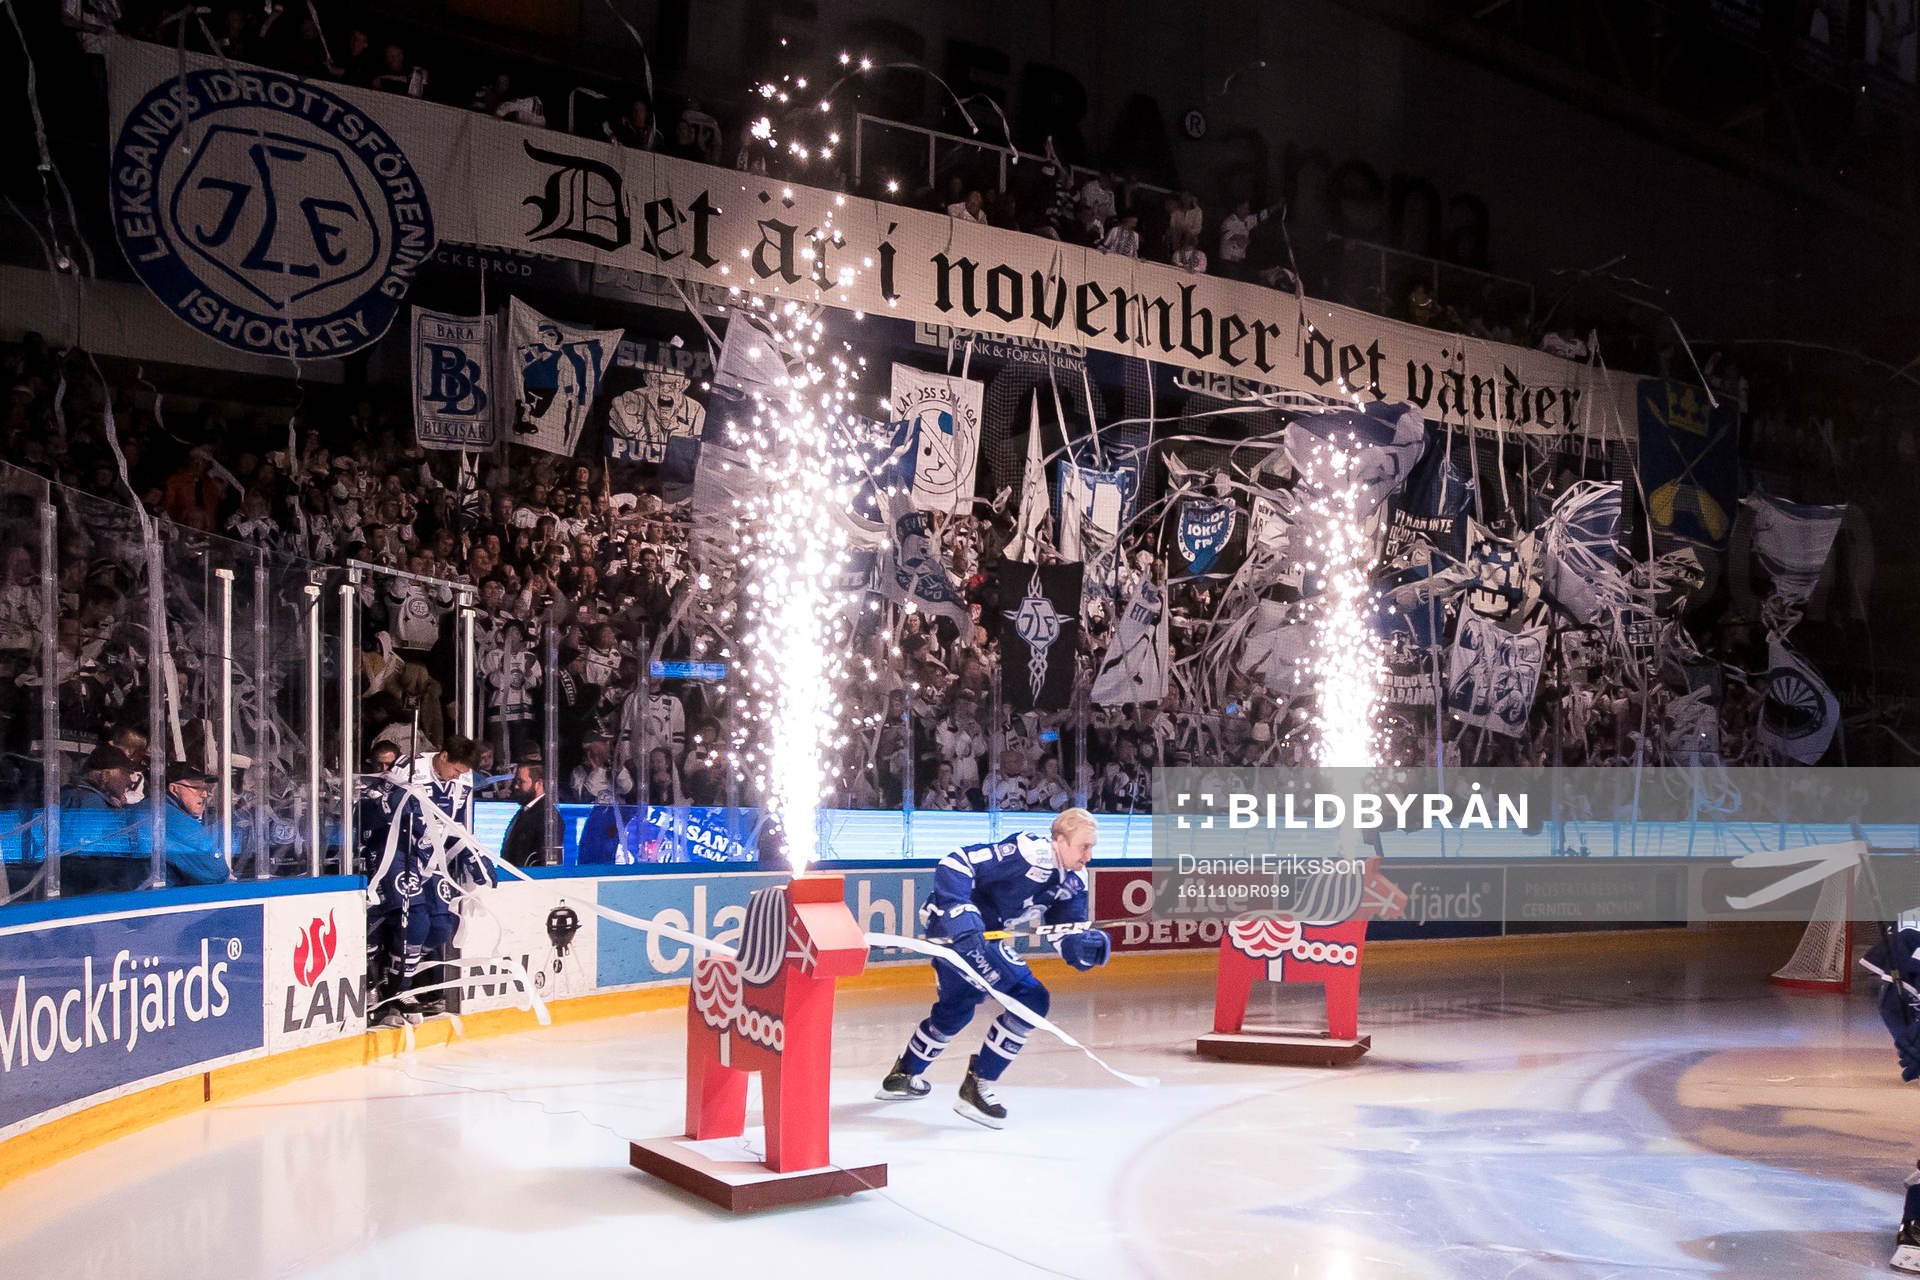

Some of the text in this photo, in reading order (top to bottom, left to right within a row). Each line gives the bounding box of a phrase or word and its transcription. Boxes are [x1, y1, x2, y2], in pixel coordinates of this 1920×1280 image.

[119, 84, 201, 263] LEKSANDS
[177, 288, 371, 353] ISHOCKEY
[437, 324, 474, 340] BARA
[522, 138, 722, 269] Det
[751, 189, 846, 292] är
[877, 222, 901, 300] i
[930, 252, 1280, 373] november
[1303, 318, 1387, 401] det
[1406, 348, 1581, 431] vänder
